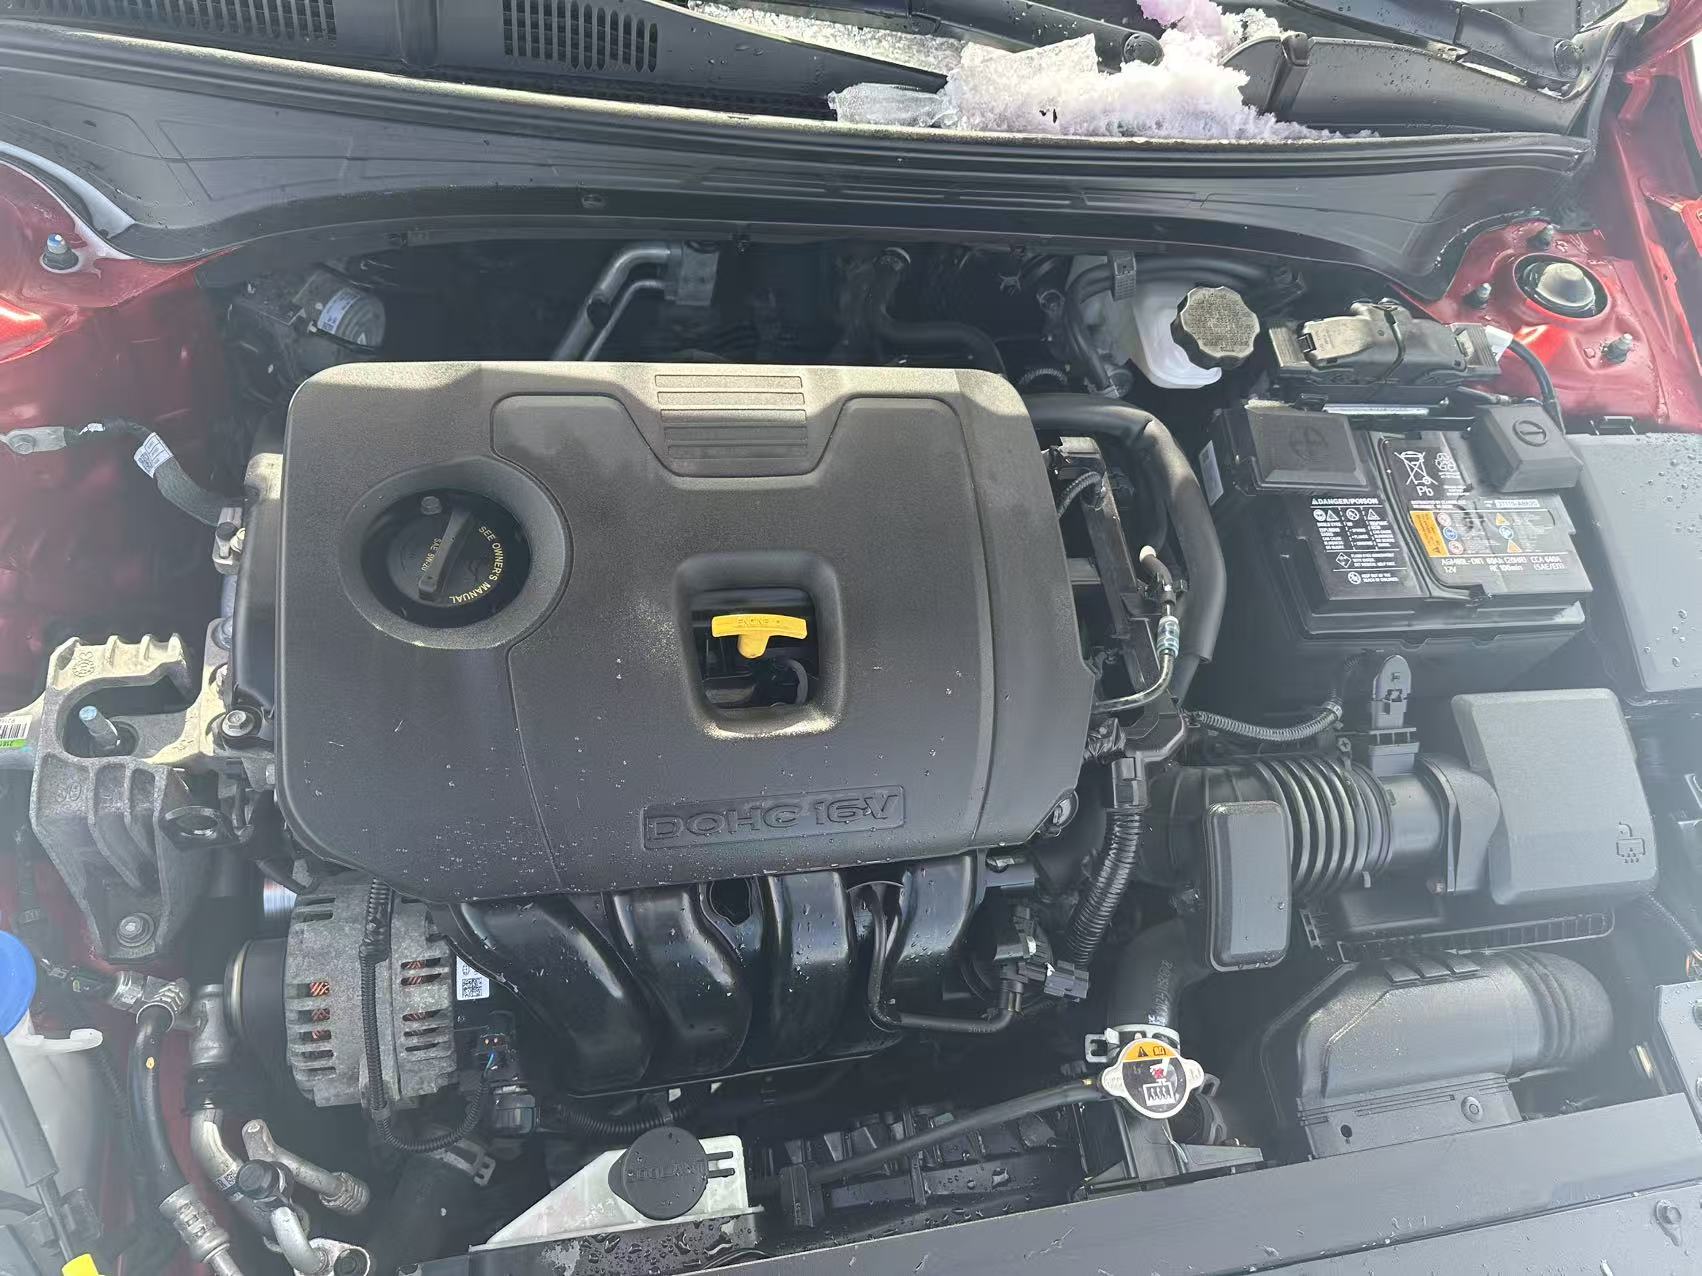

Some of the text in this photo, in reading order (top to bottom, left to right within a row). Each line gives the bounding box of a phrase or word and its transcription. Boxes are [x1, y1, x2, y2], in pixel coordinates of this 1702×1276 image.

[1416, 485, 1434, 497] Pb
[449, 525, 504, 604] SEE OWNER'S MANUAL
[1444, 566, 1456, 574] 12V
[647, 794, 899, 840] DOHC 16V
